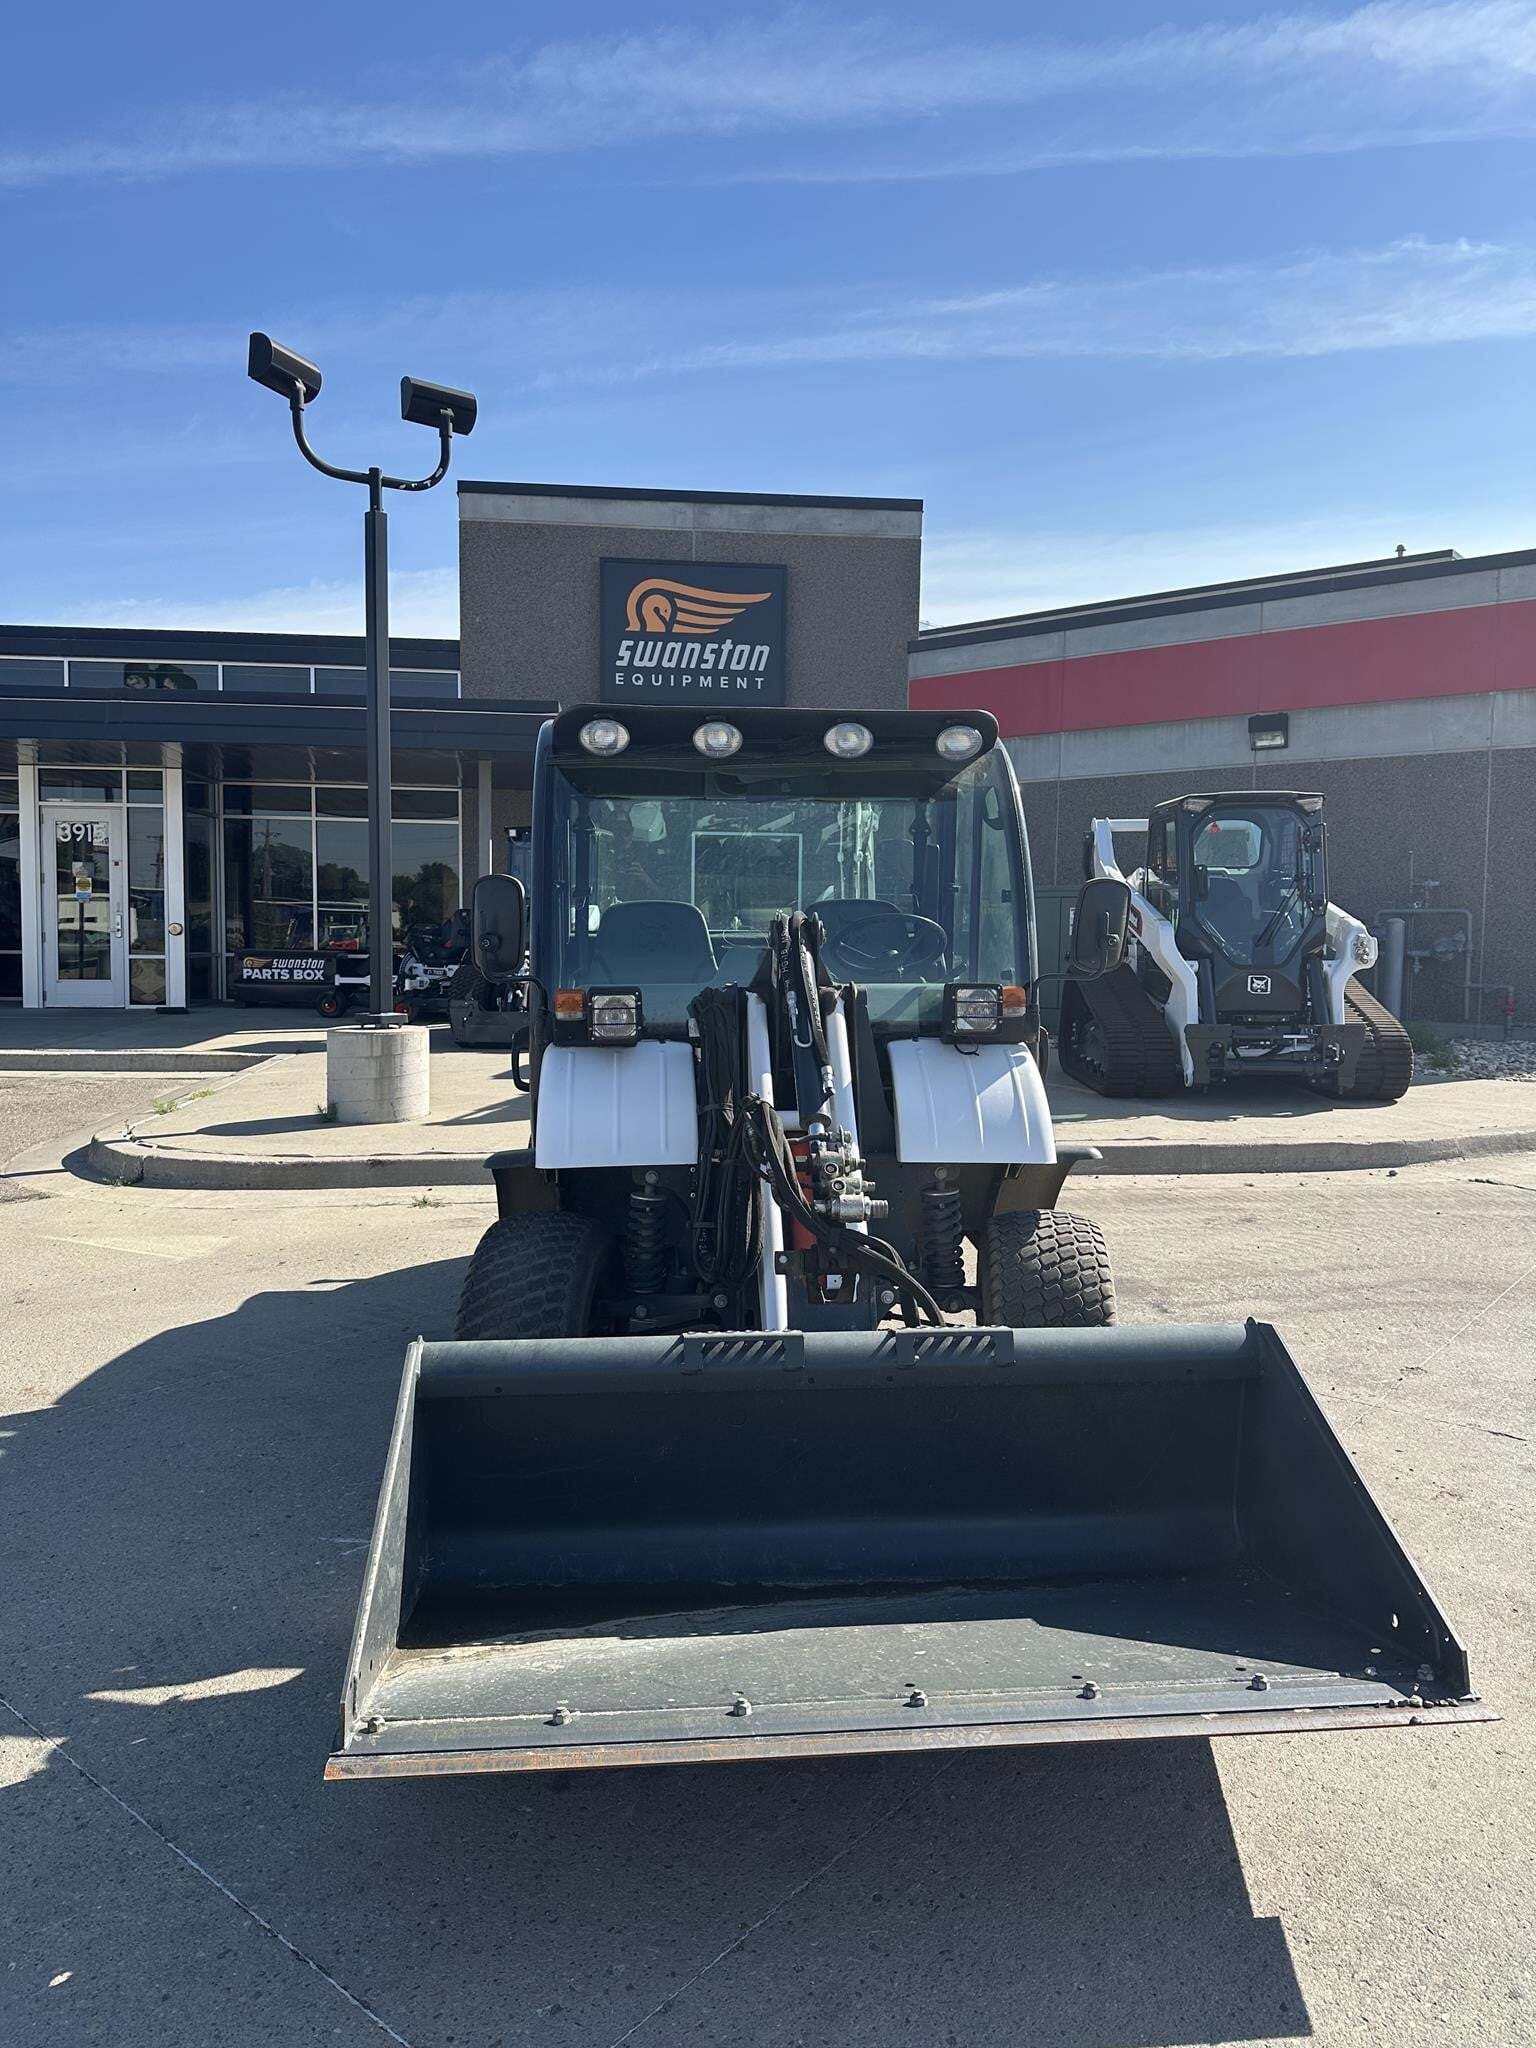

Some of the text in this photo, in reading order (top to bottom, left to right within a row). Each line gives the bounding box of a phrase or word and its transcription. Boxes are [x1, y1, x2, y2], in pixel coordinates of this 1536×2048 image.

[615, 639, 771, 672] swanston
[615, 672, 765, 690] EQUIPMENT
[242, 968, 325, 981] PARTS BOX
